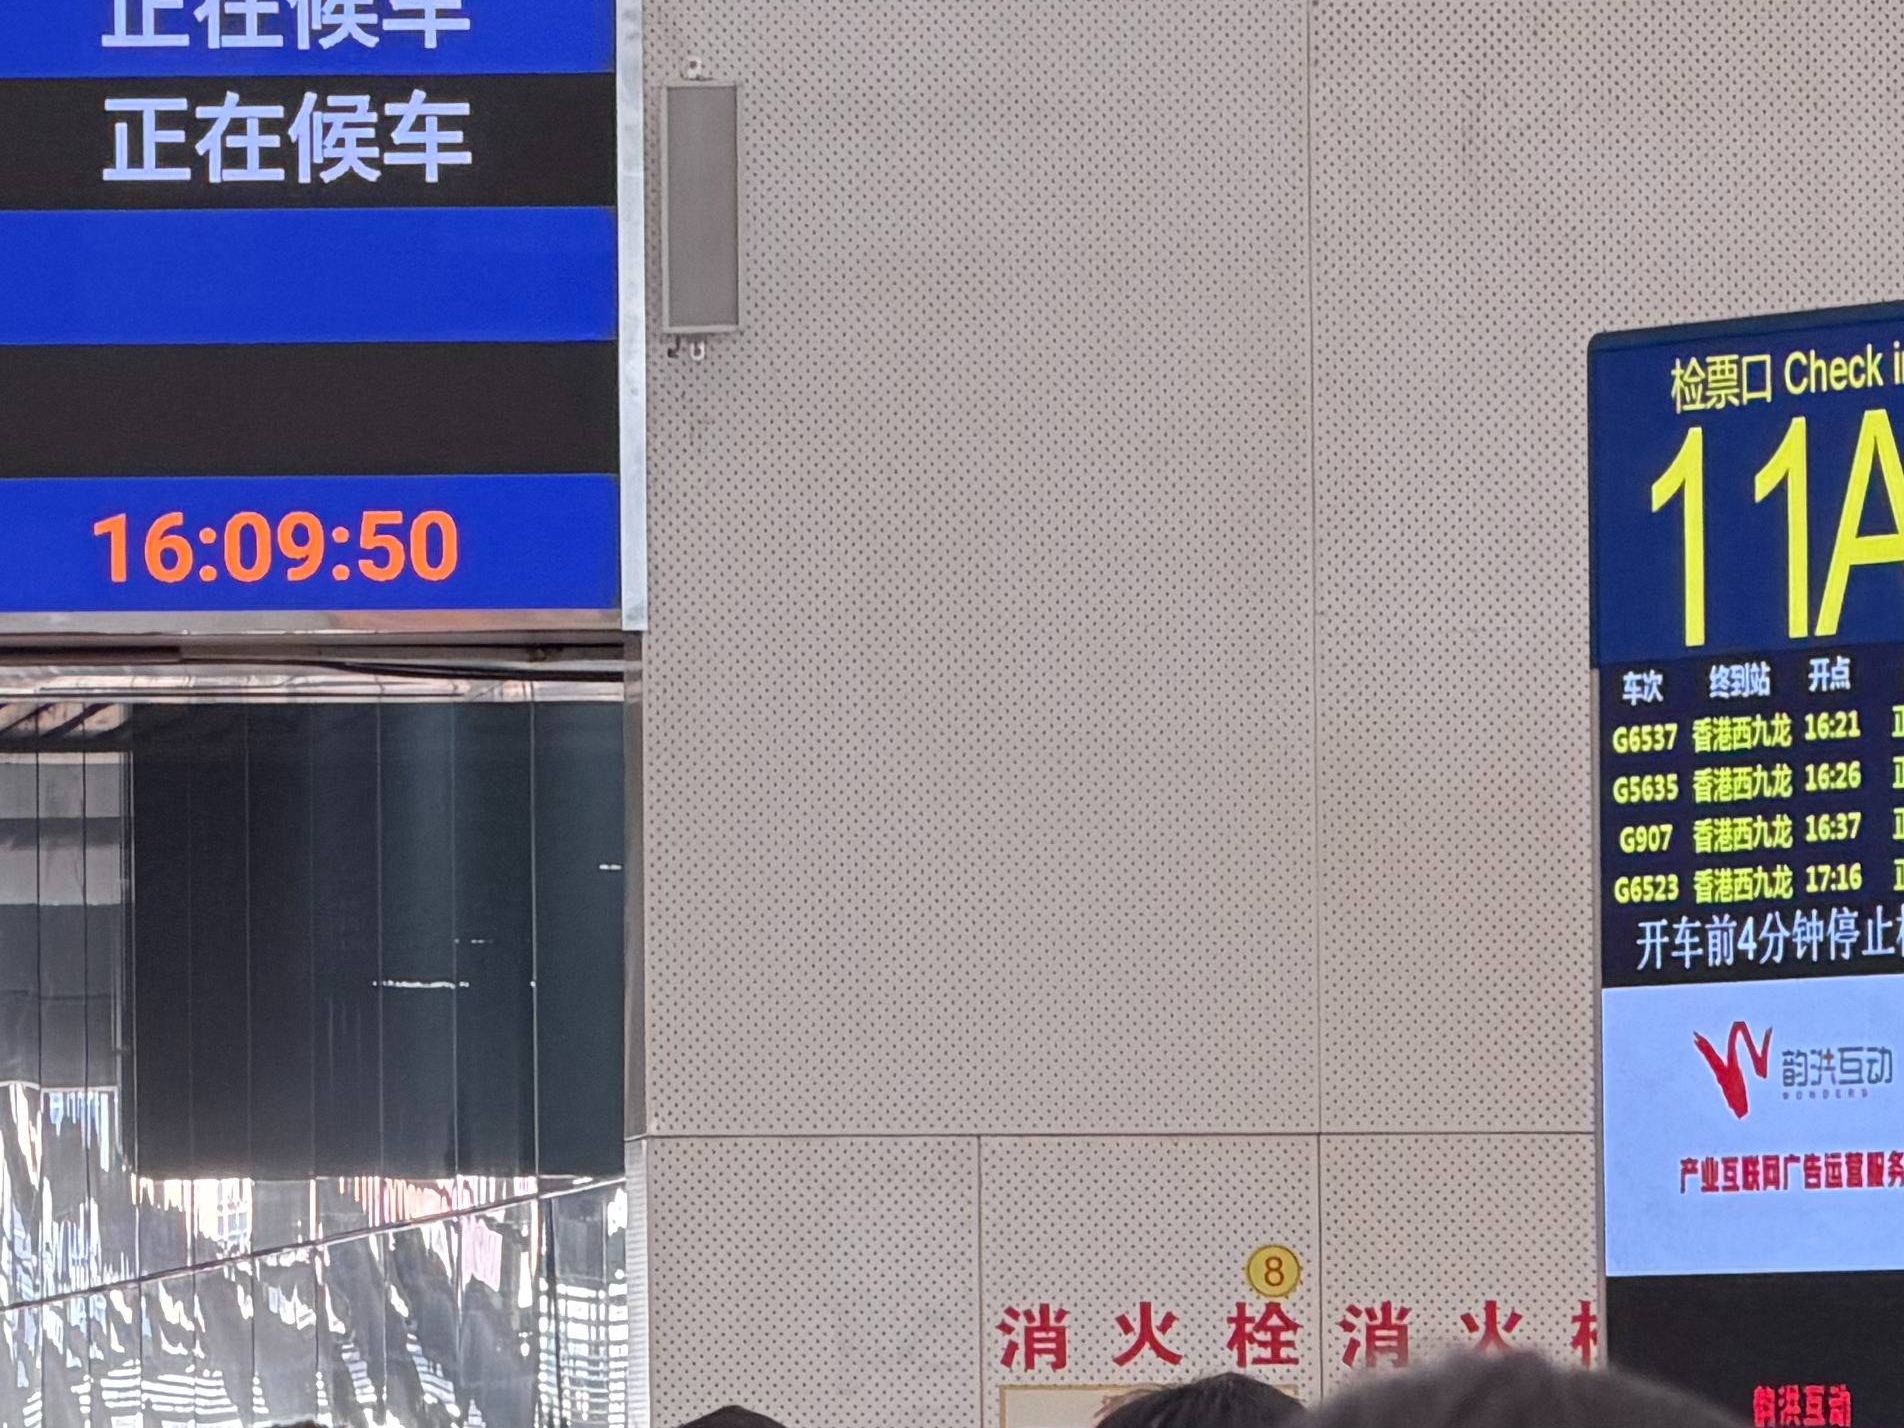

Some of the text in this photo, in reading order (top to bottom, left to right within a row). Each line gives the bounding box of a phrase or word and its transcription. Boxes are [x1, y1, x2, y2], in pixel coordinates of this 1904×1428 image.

[103, 89, 472, 183] 正在候车
[1672, 354, 1772, 414] 检票口
[1784, 342, 1884, 398] Check
[93, 510, 459, 584] 16:09:50
[1651, 408, 1904, 647] 11A
[1622, 655, 1851, 706] 车次 终到站 开点
[1612, 724, 1678, 754] G6537
[1692, 712, 1793, 754] 香港西九龙
[1804, 710, 1861, 741] 16:21
[1613, 774, 1679, 805] G5635
[1692, 763, 1793, 803] 香港西九龙
[1804, 760, 1862, 792] 16:26
[1619, 824, 1673, 854] G907
[1692, 814, 1794, 854] 香港西九龙
[1805, 811, 1862, 843] 16:37
[1614, 874, 1679, 904] G6523
[1693, 864, 1794, 904] 香港西九龙
[1805, 862, 1863, 893] 17:16
[1263, 1256, 1285, 1286] 8
[995, 1301, 1303, 1371] 消火栓
